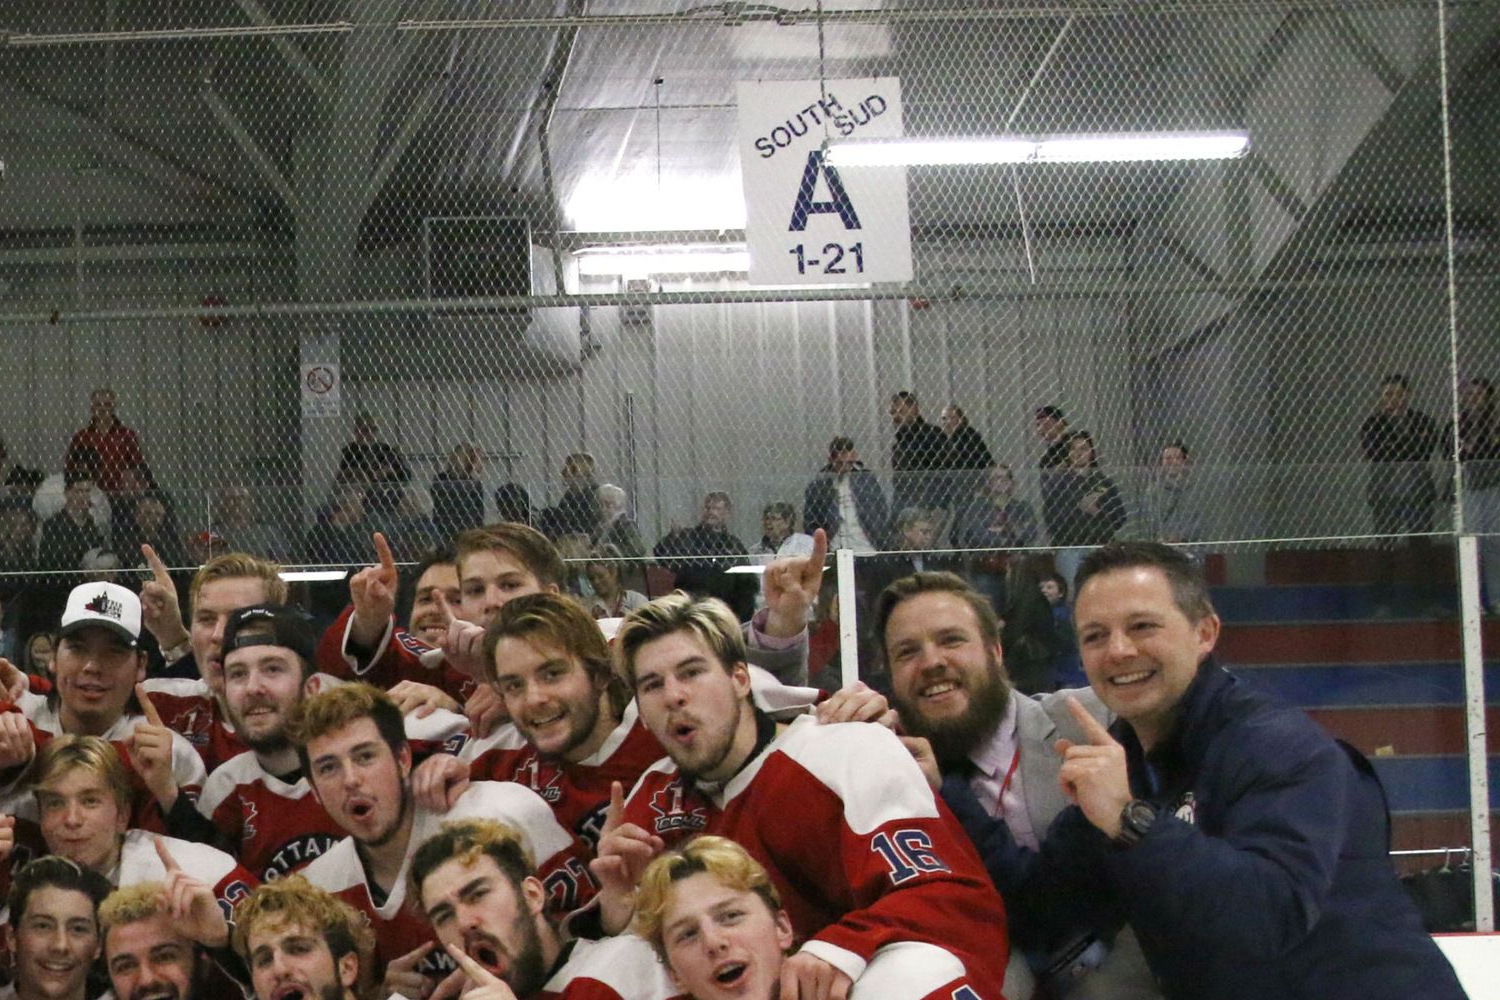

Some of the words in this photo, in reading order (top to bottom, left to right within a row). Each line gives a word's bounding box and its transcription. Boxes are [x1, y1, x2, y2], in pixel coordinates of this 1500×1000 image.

[754, 92, 843, 159] SOUTH
[833, 94, 887, 137] SUD
[788, 150, 862, 232] A
[788, 242, 865, 275] 1-21
[871, 829, 952, 886] 16
